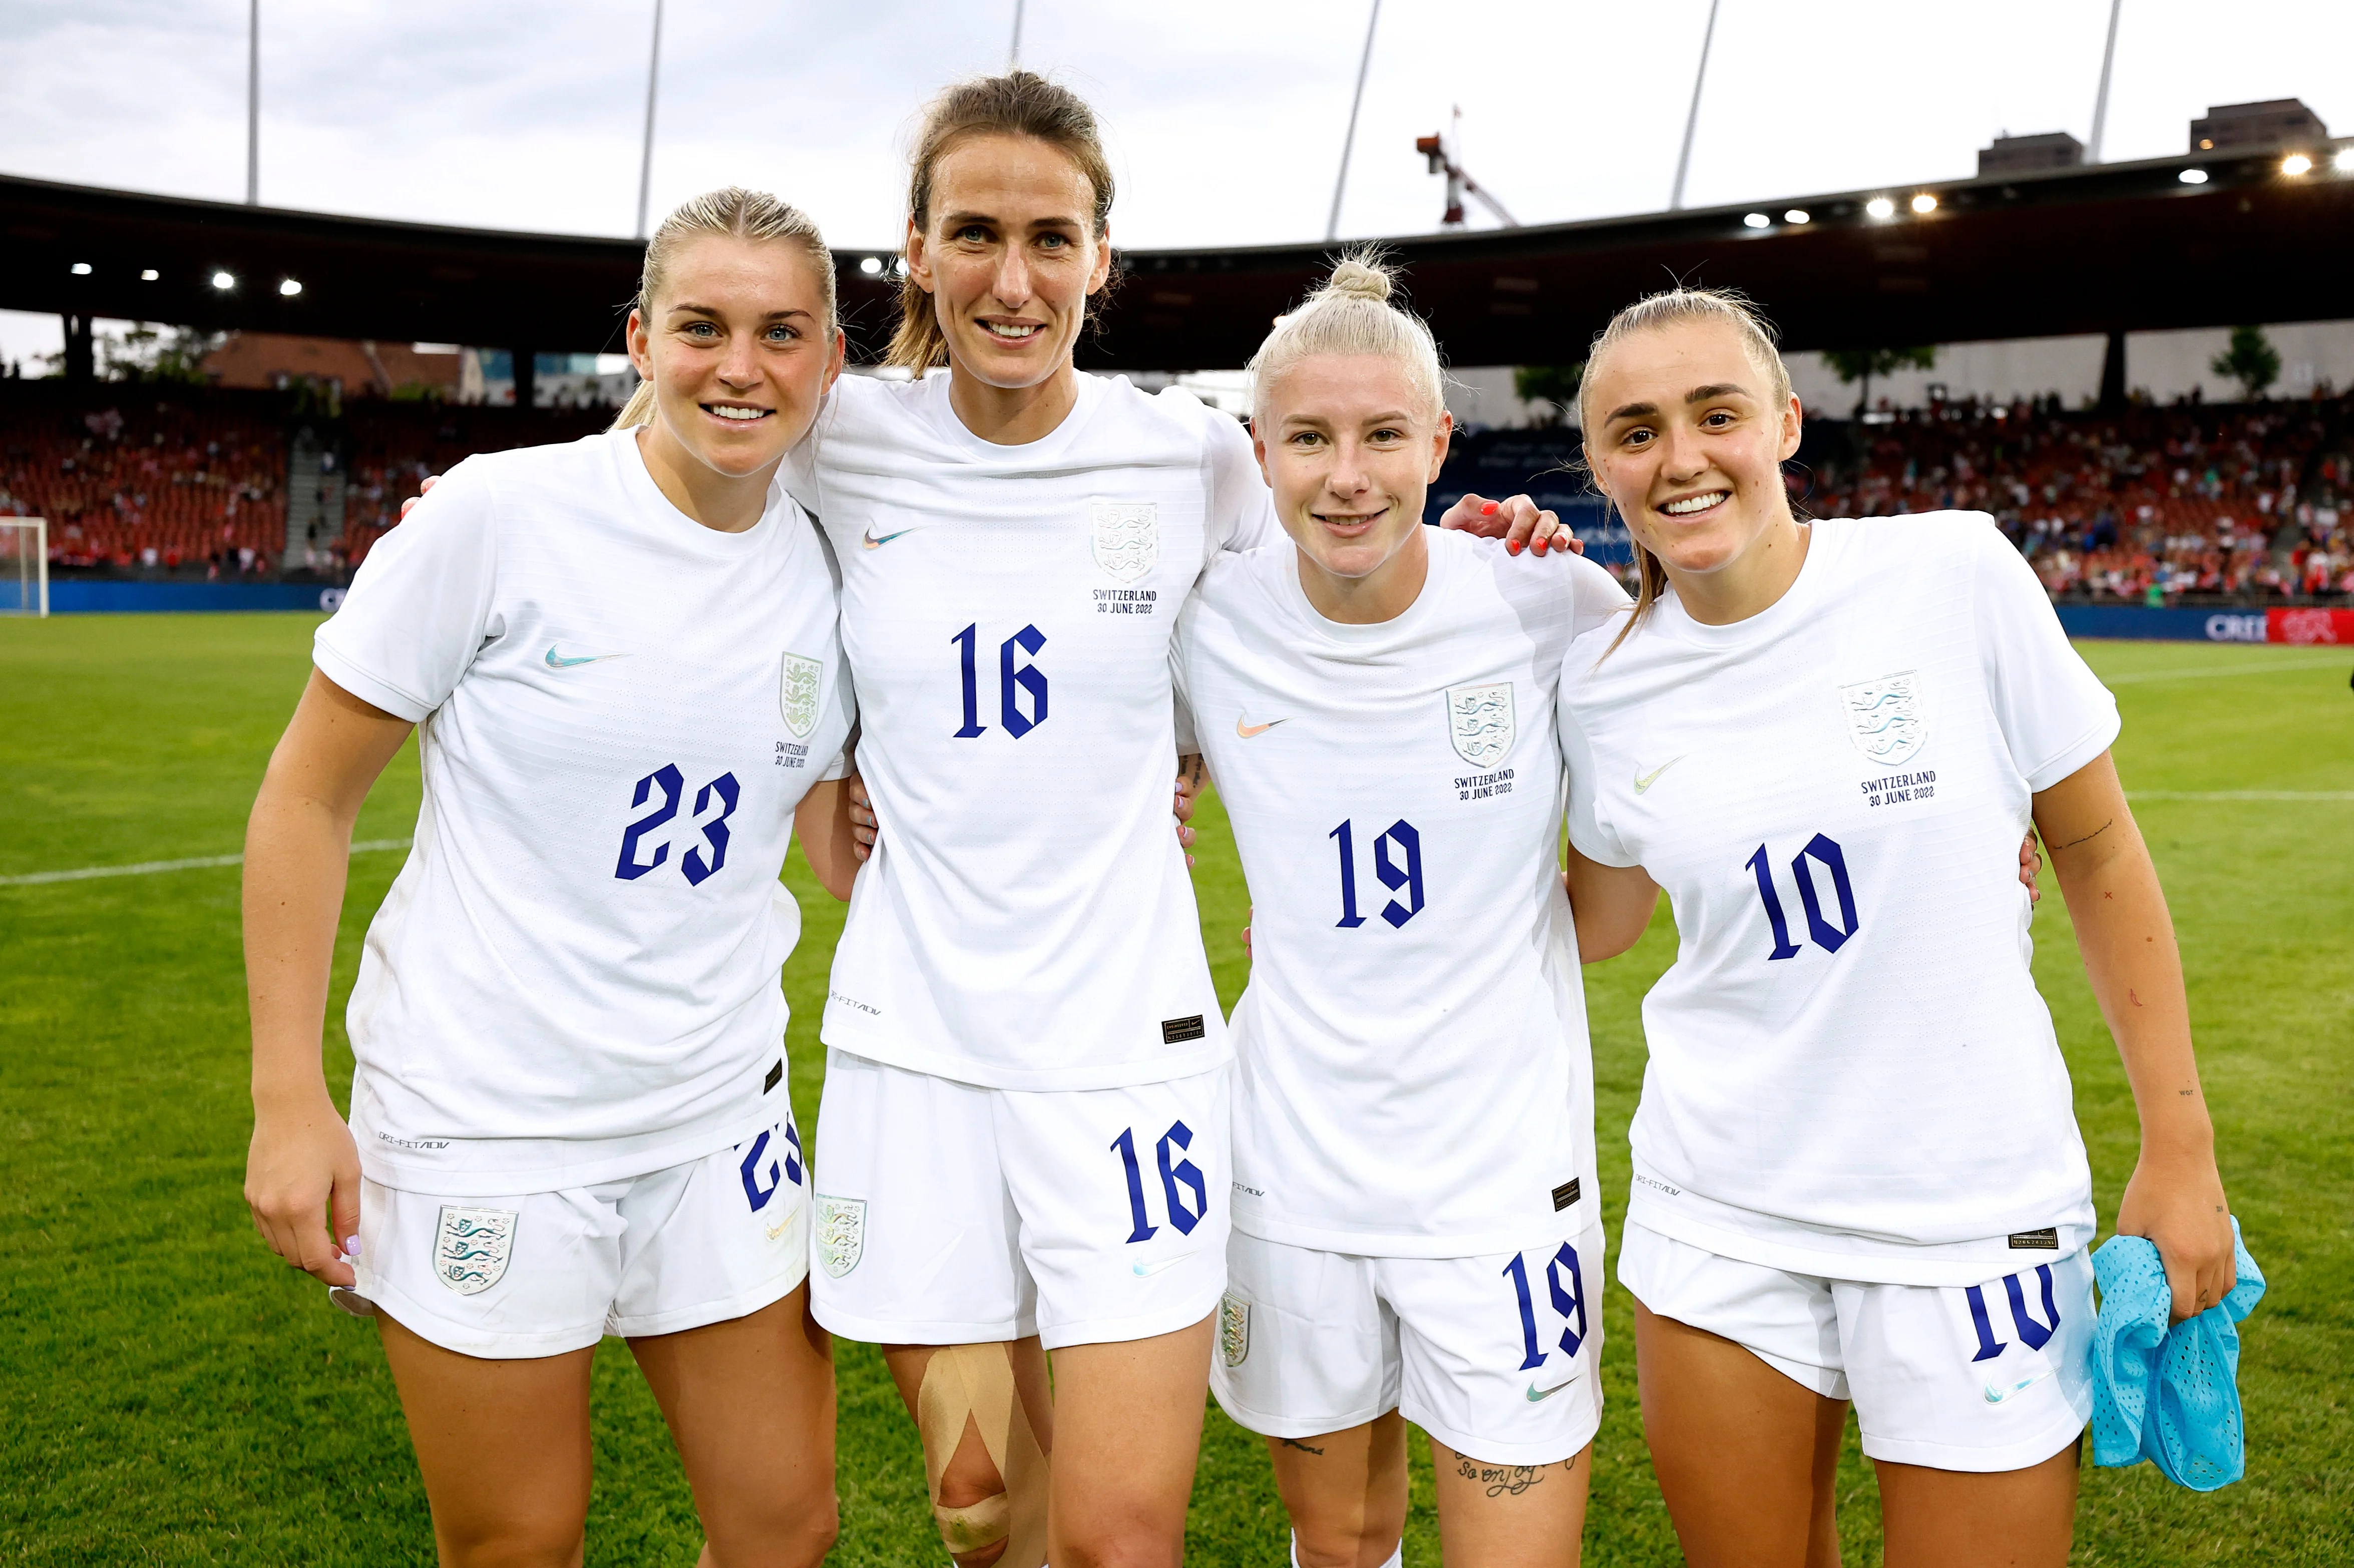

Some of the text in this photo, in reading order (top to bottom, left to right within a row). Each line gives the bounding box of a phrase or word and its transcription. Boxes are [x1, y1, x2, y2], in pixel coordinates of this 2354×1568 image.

[1093, 589, 1156, 601] SWITZERLAND
[1097, 603, 1152, 614] 30 JUNE 2022
[952, 622, 1047, 739] 16
[775, 741, 809, 756] SWITZERLAND
[775, 755, 783, 765] 30
[782, 756, 797, 768] JUNE
[1454, 768, 1514, 789] SWITZERLAND
[1861, 770, 1936, 794] SWITZERLAND
[1460, 782, 1512, 801] 30 JUNE 2022
[1869, 786, 1934, 807] 30 JUNE 2022
[615, 763, 740, 886] 23
[1330, 818, 1424, 929] 19
[1745, 833, 1859, 960] 10
[1110, 1119, 1208, 1244] 16
[1233, 1182, 1265, 1197] FITADV
[1502, 1241, 1587, 1371] 19
